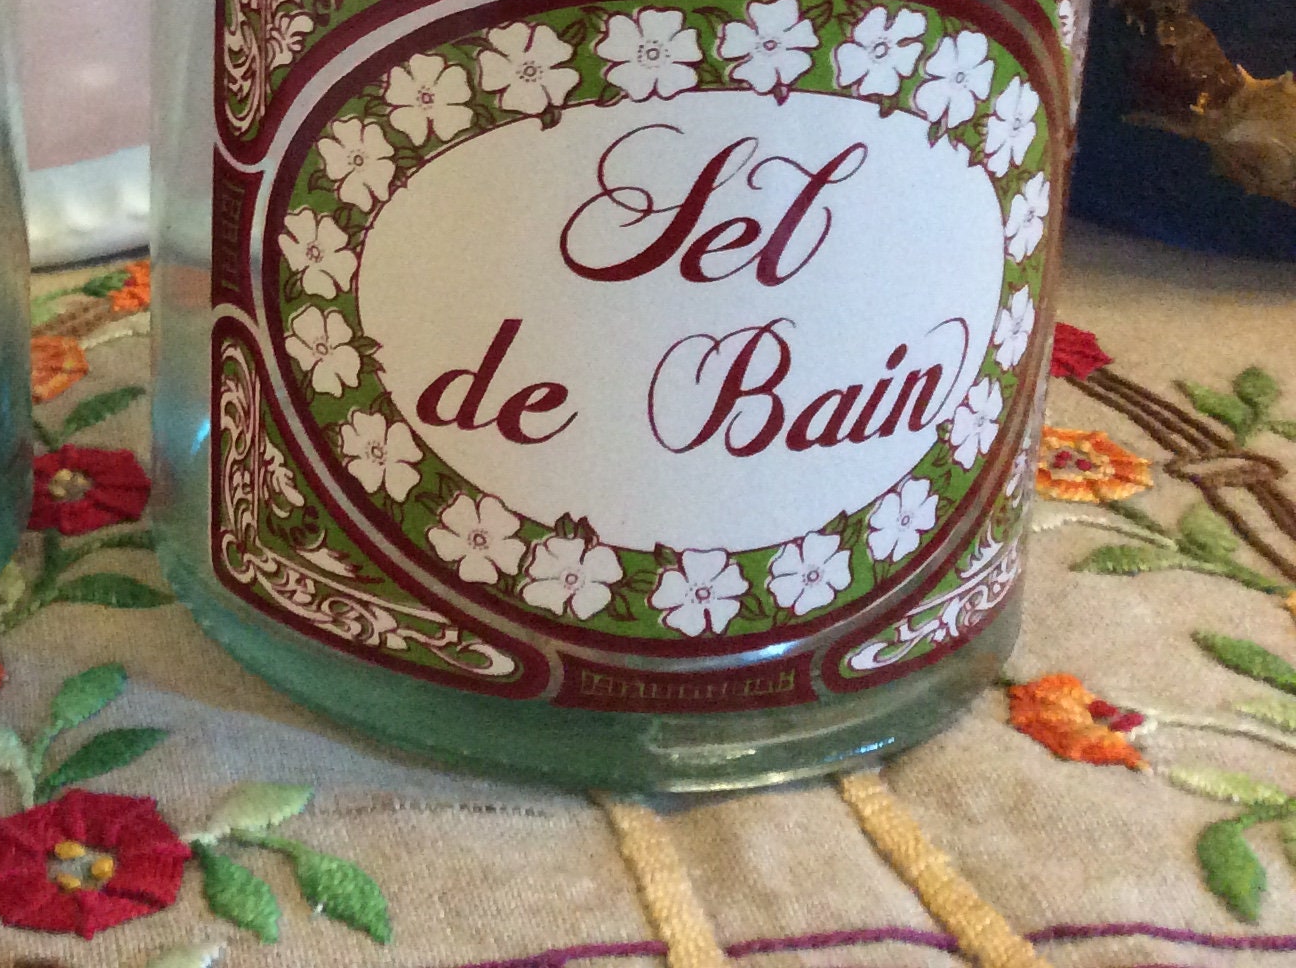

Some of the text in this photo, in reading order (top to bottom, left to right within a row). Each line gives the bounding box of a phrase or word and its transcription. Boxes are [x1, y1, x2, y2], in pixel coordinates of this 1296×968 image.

[559, 123, 869, 287] Sel
[415, 317, 970, 458] de Bain
